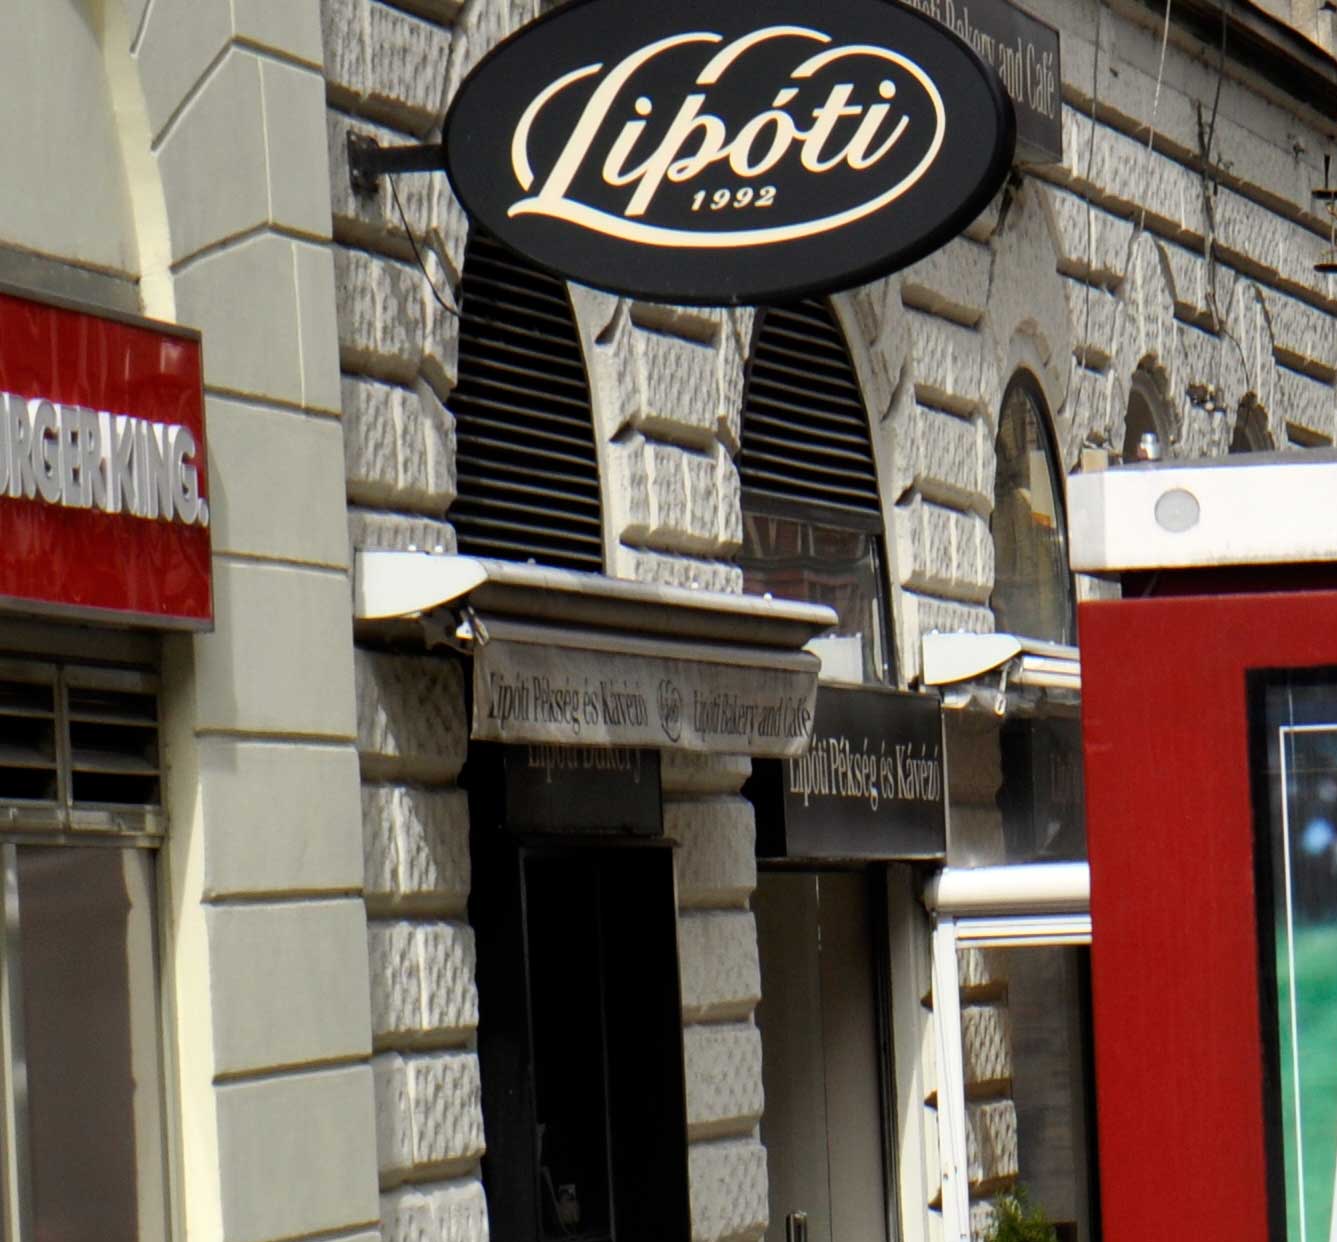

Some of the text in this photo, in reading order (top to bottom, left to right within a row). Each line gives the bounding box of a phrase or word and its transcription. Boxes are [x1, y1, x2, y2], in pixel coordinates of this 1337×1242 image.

[1026, 42, 1055, 120] Café
[508, 29, 930, 242] Lipóti
[691, 185, 777, 212] 1992
[829, 735, 879, 812] Pékség
[880, 738, 895, 799] és
[895, 741, 941, 801] Kávézó
